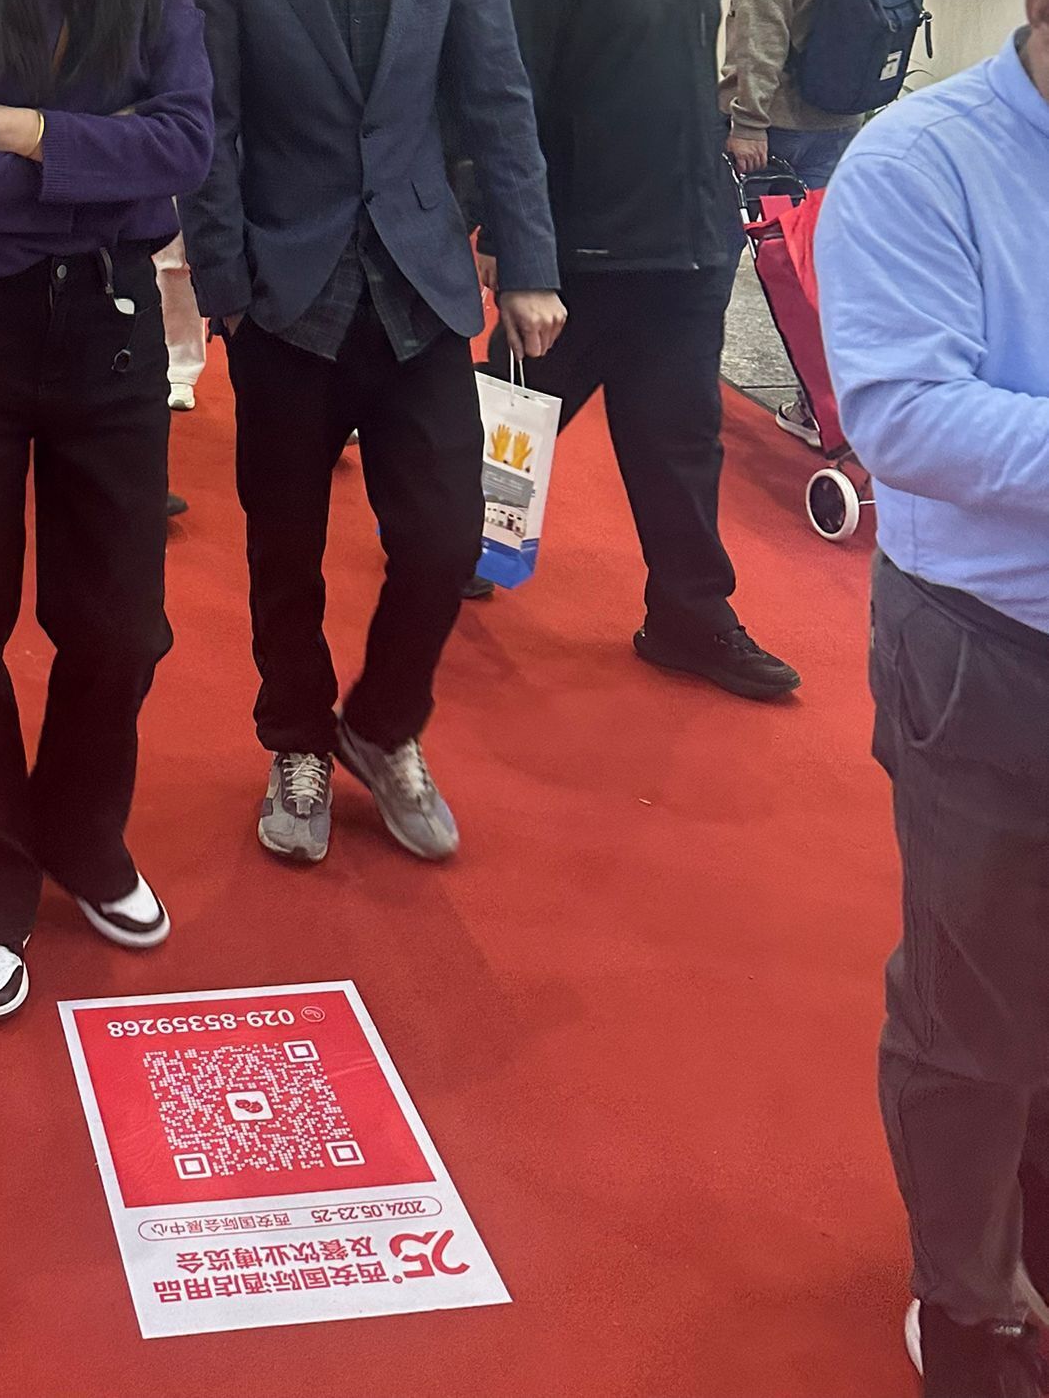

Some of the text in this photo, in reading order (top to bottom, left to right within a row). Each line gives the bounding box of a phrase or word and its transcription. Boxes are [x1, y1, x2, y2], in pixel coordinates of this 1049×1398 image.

[106, 1006, 296, 1039] 029-85359268
[150, 1200, 427, 1236] 2024.05.23-25 西安国际会展中心
[176, 1236, 378, 1274] 及餐饮业博览会
[153, 1260, 390, 1303] 西安国际酒店用品
